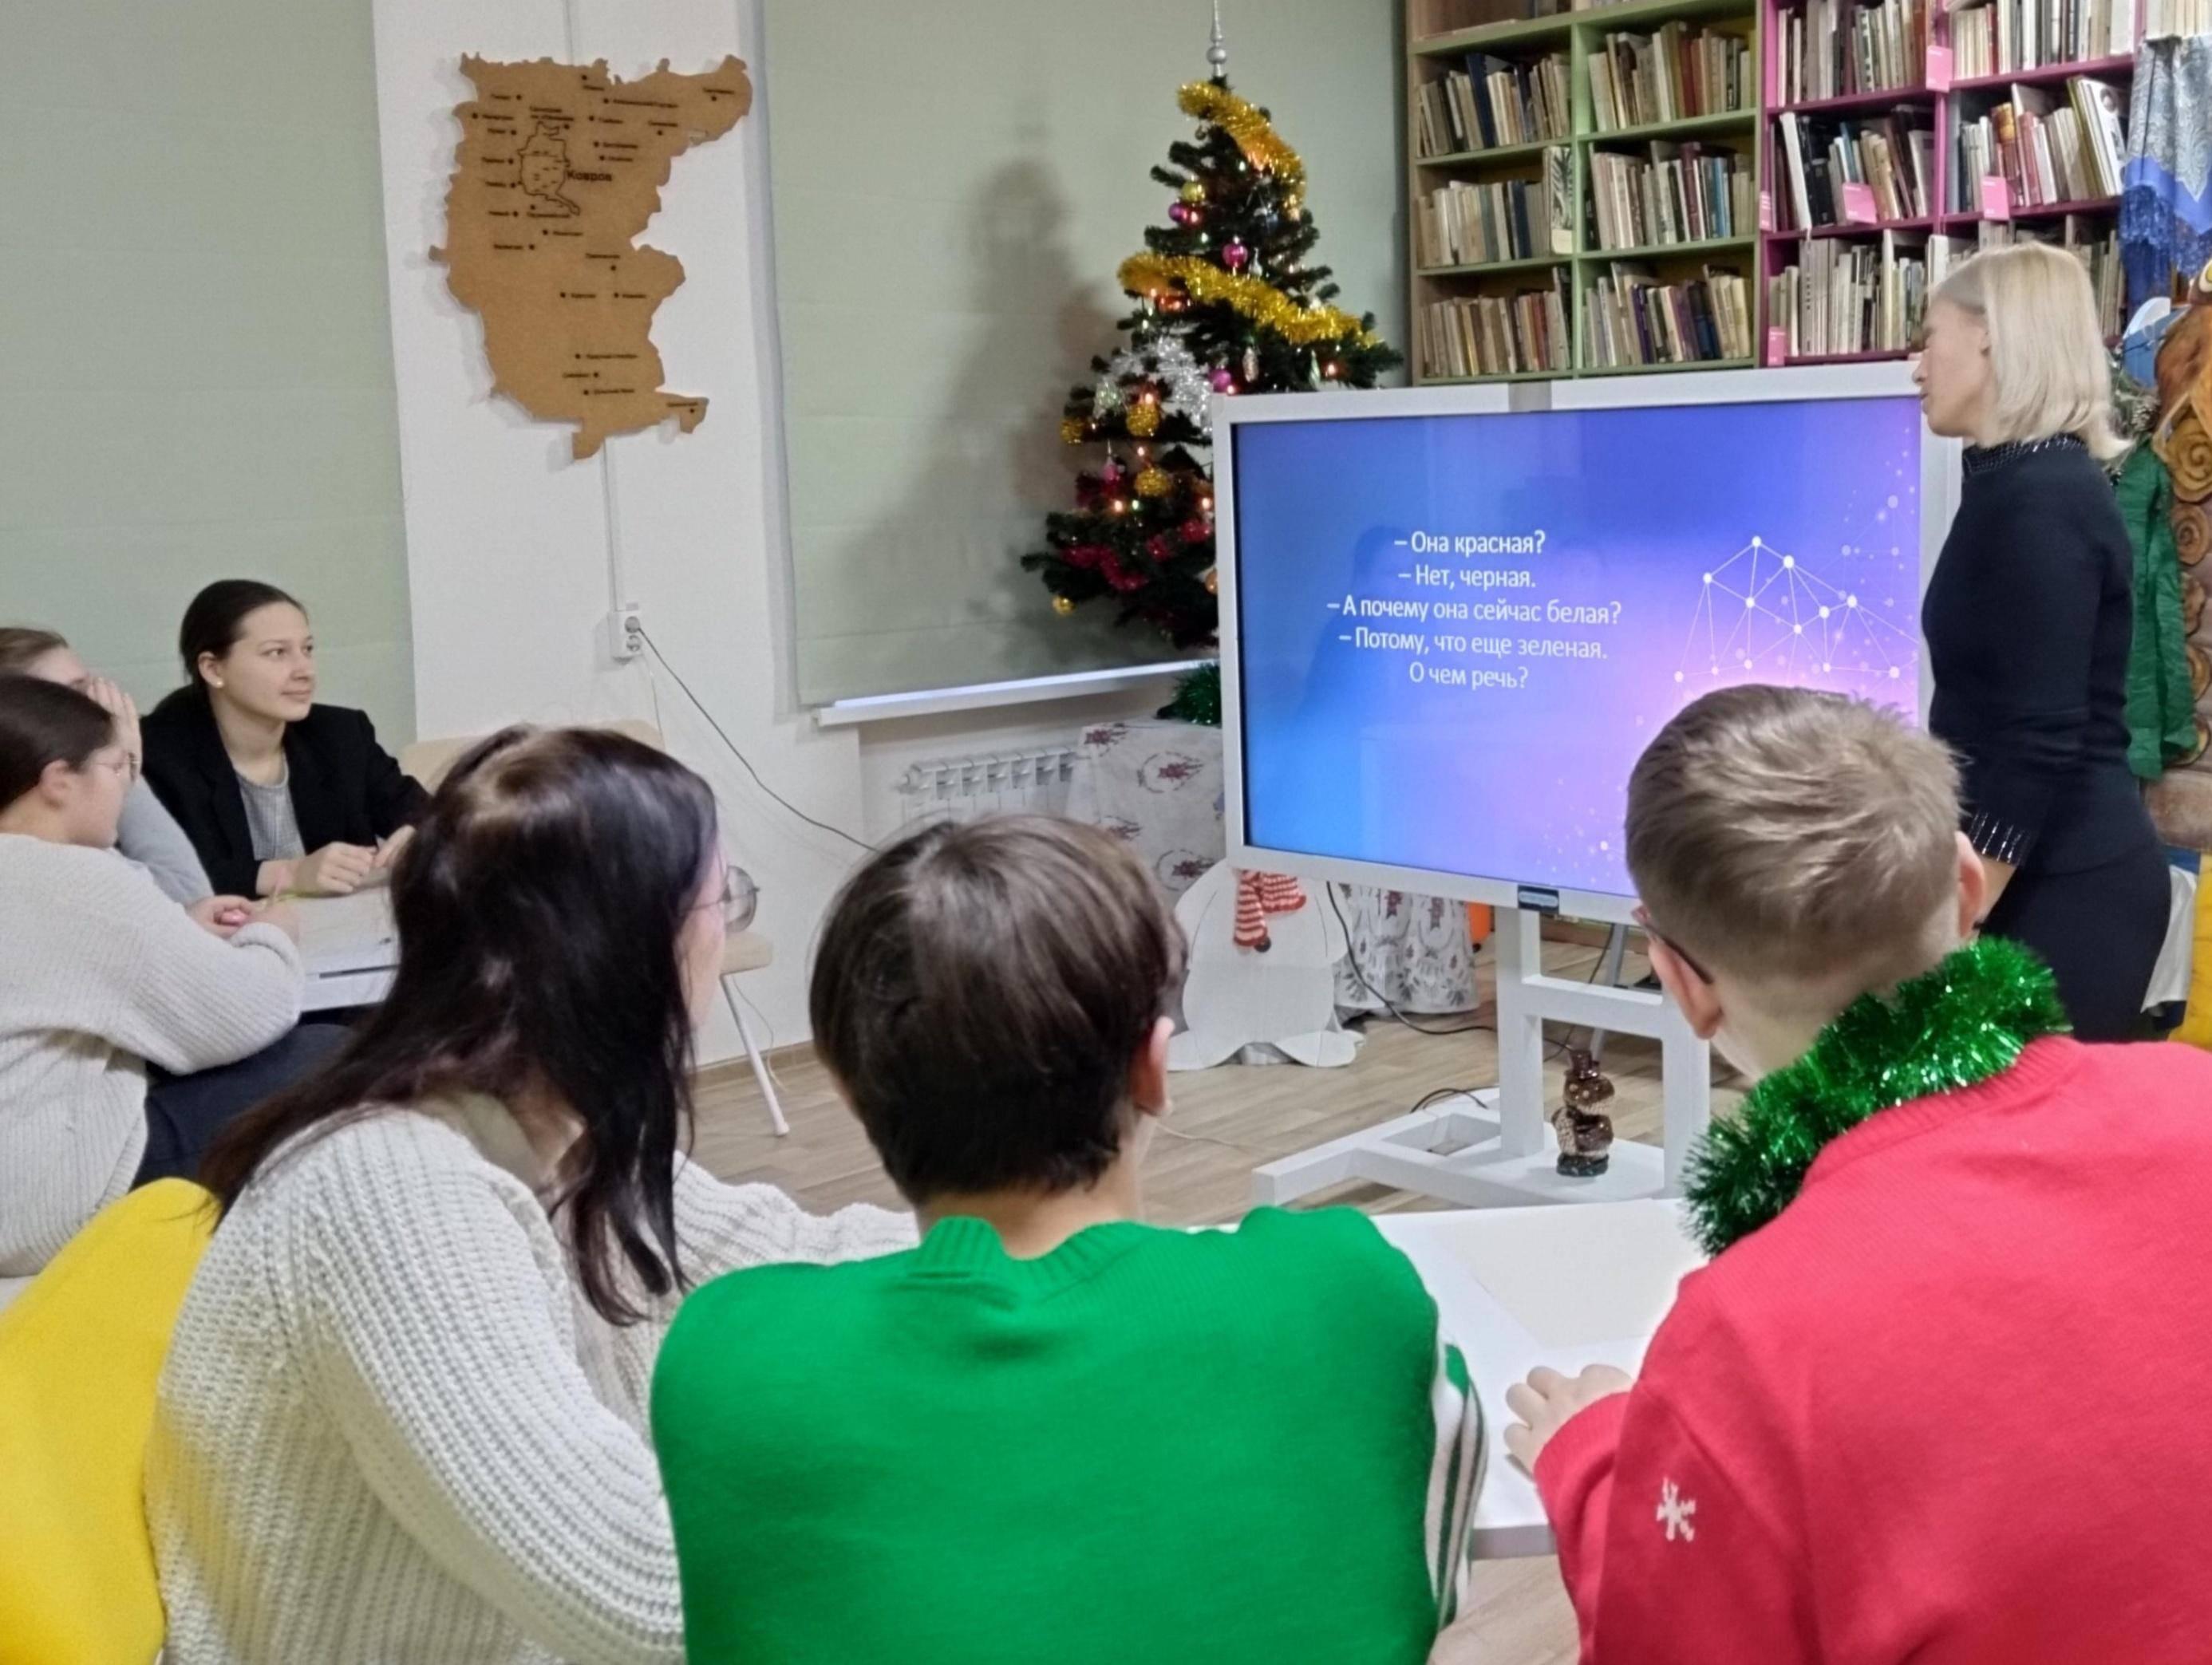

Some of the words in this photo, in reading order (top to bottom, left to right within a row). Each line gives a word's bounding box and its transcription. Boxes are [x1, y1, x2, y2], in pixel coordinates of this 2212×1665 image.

[1411, 530, 1449, 554] Она
[1454, 529, 1546, 558] красная?
[1416, 563, 1455, 590] Нет,
[1460, 570, 1536, 592] черная.
[1342, 594, 1357, 617] А
[1360, 599, 1430, 623] почему
[1433, 602, 1468, 620] она
[1473, 598, 1542, 621] сейчас
[1546, 598, 1622, 625] белая?
[1355, 627, 1429, 655] Потому,
[1434, 635, 1467, 653] что
[1471, 637, 1511, 659] еще
[1518, 638, 1607, 659] зеленая.
[1409, 661, 1424, 684] О
[1429, 668, 1467, 685] чем
[1471, 666, 1529, 691] речь?
